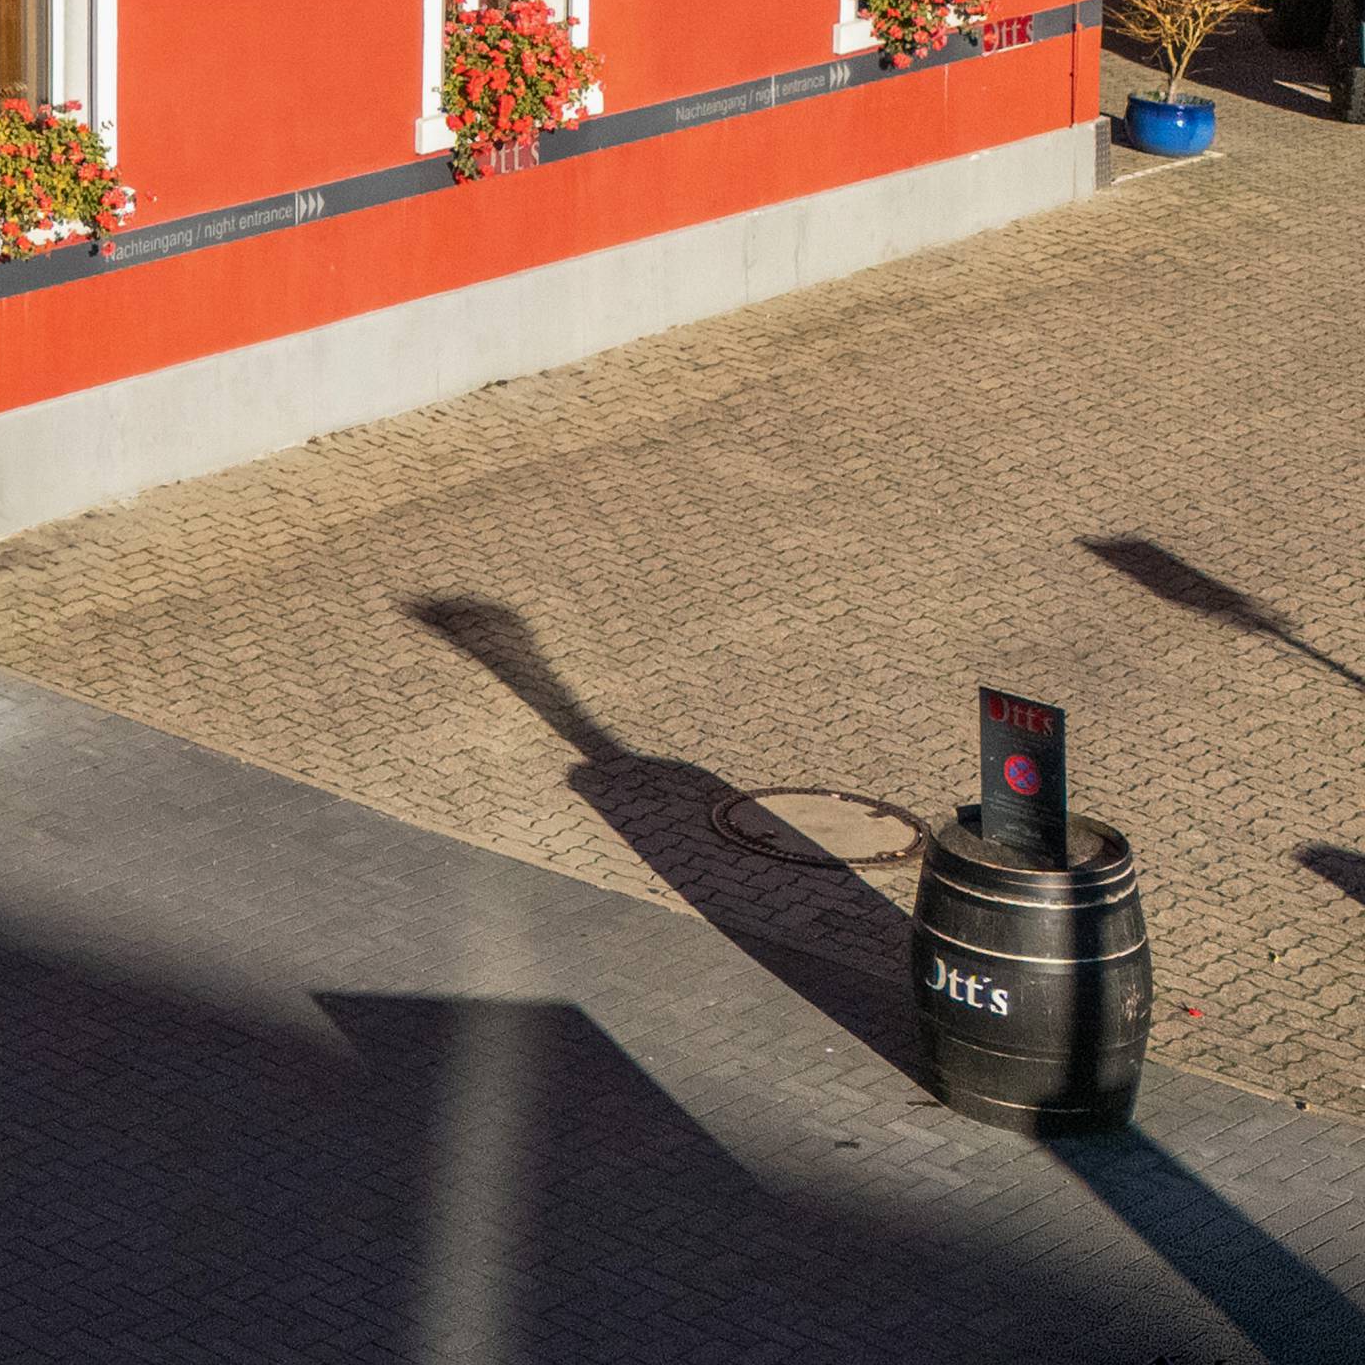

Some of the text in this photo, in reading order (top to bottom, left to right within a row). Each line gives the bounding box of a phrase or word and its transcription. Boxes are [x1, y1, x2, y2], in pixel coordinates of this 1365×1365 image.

[675, 92, 747, 122] Nachteingang
[781, 74, 827, 96] entrance
[203, 217, 237, 241] night
[238, 204, 294, 231] entrance
